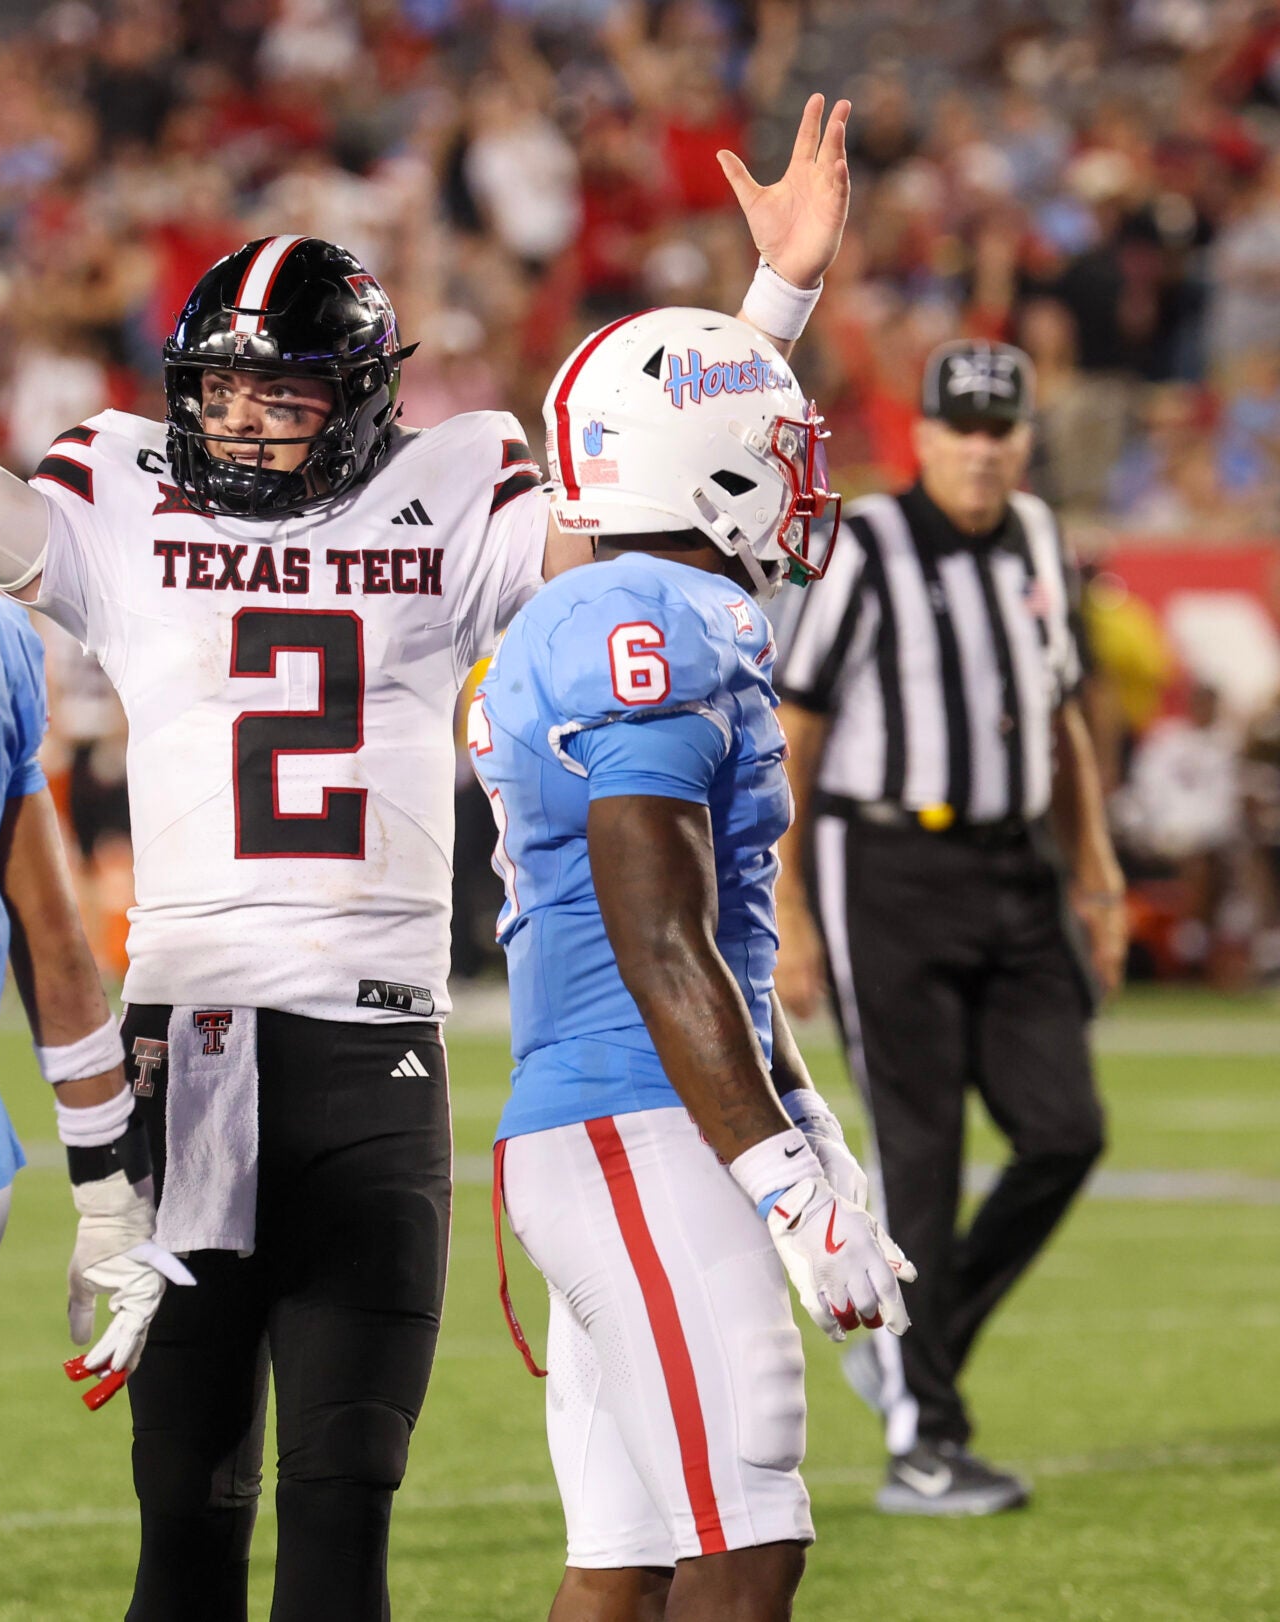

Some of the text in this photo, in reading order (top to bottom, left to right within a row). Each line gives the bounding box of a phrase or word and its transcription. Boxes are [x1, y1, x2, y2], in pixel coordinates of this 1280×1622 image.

[556, 509, 601, 529] Houston
[153, 540, 445, 596] TEXAS TECH
[607, 620, 671, 706] 6
[230, 606, 368, 860] 2
